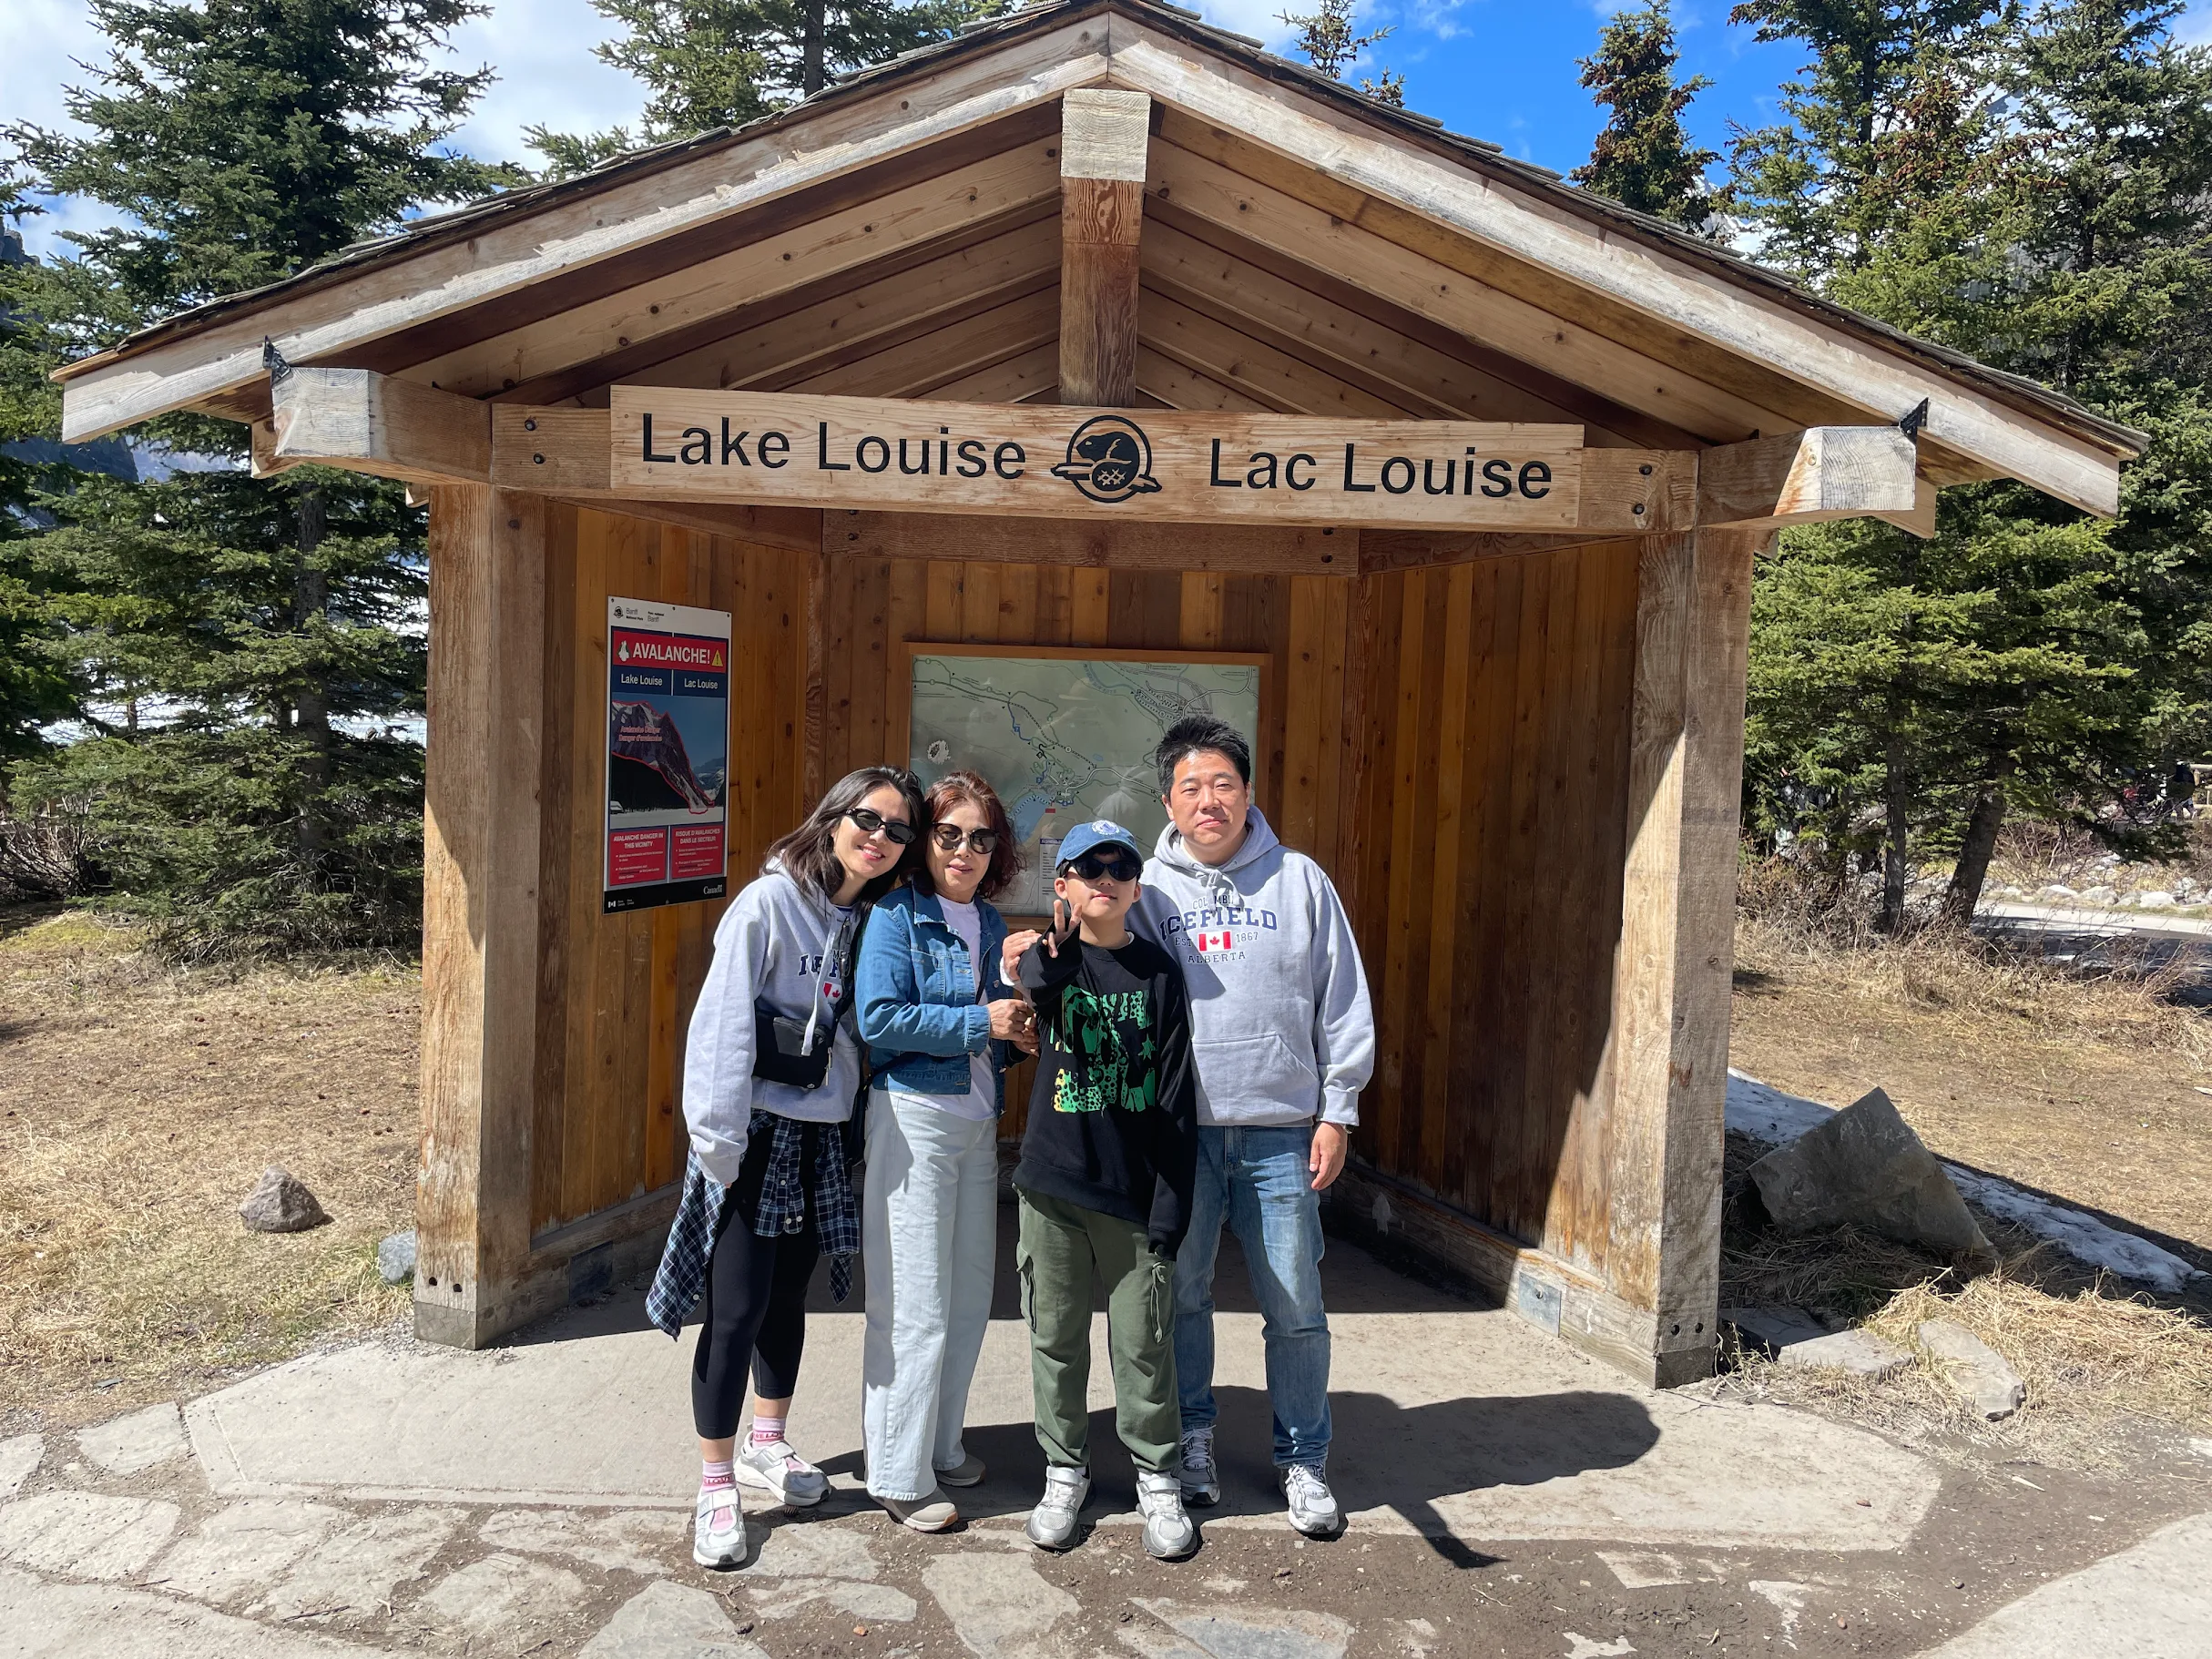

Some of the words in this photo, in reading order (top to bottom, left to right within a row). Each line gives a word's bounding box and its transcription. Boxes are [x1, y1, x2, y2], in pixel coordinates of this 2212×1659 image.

[642, 412, 790, 469] Lake
[818, 422, 1026, 480] Louise
[1209, 438, 1317, 491] Lac
[1343, 443, 1552, 500] Louise
[626, 607, 638, 616] Banff
[647, 615, 659, 623] Banff
[632, 642, 710, 665] AVALANCHE!
[621, 673, 638, 684] Lake
[640, 675, 663, 686] Louise
[684, 677, 696, 688] Lac
[698, 678, 719, 689] Louise
[613, 833, 639, 841] AVALANCHE
[640, 832, 658, 840] DANGER
[703, 885, 722, 894] Canada
[1159, 906, 1278, 941] ICEFIELD
[1175, 937, 1192, 947] EST
[1236, 931, 1259, 943] 1867
[1188, 952, 1246, 963] ALBERTA
